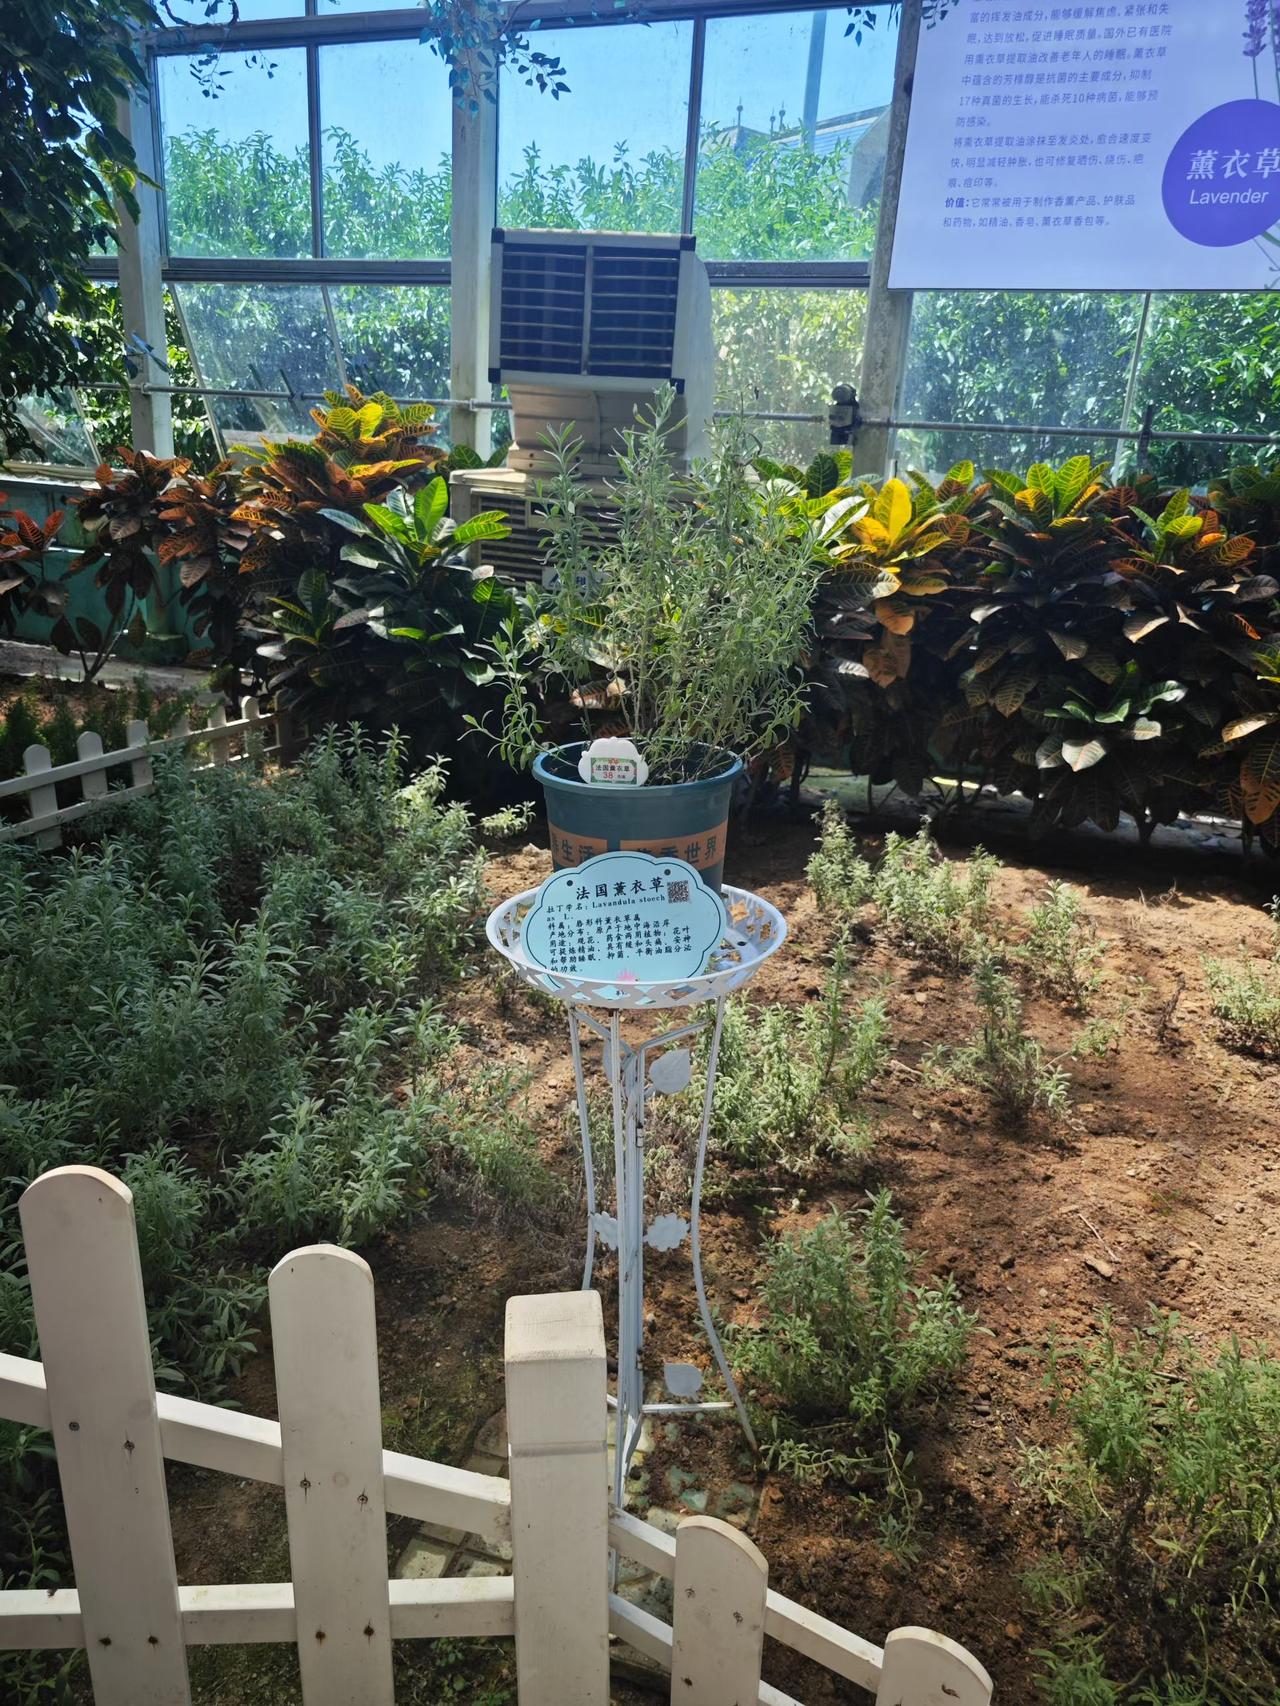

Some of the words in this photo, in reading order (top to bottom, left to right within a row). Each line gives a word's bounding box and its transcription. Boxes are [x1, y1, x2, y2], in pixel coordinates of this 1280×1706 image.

[1186, 148, 1280, 180] 薰衣草
[1190, 188, 1269, 204] Lavender
[576, 877, 664, 900] 法国薰衣草
